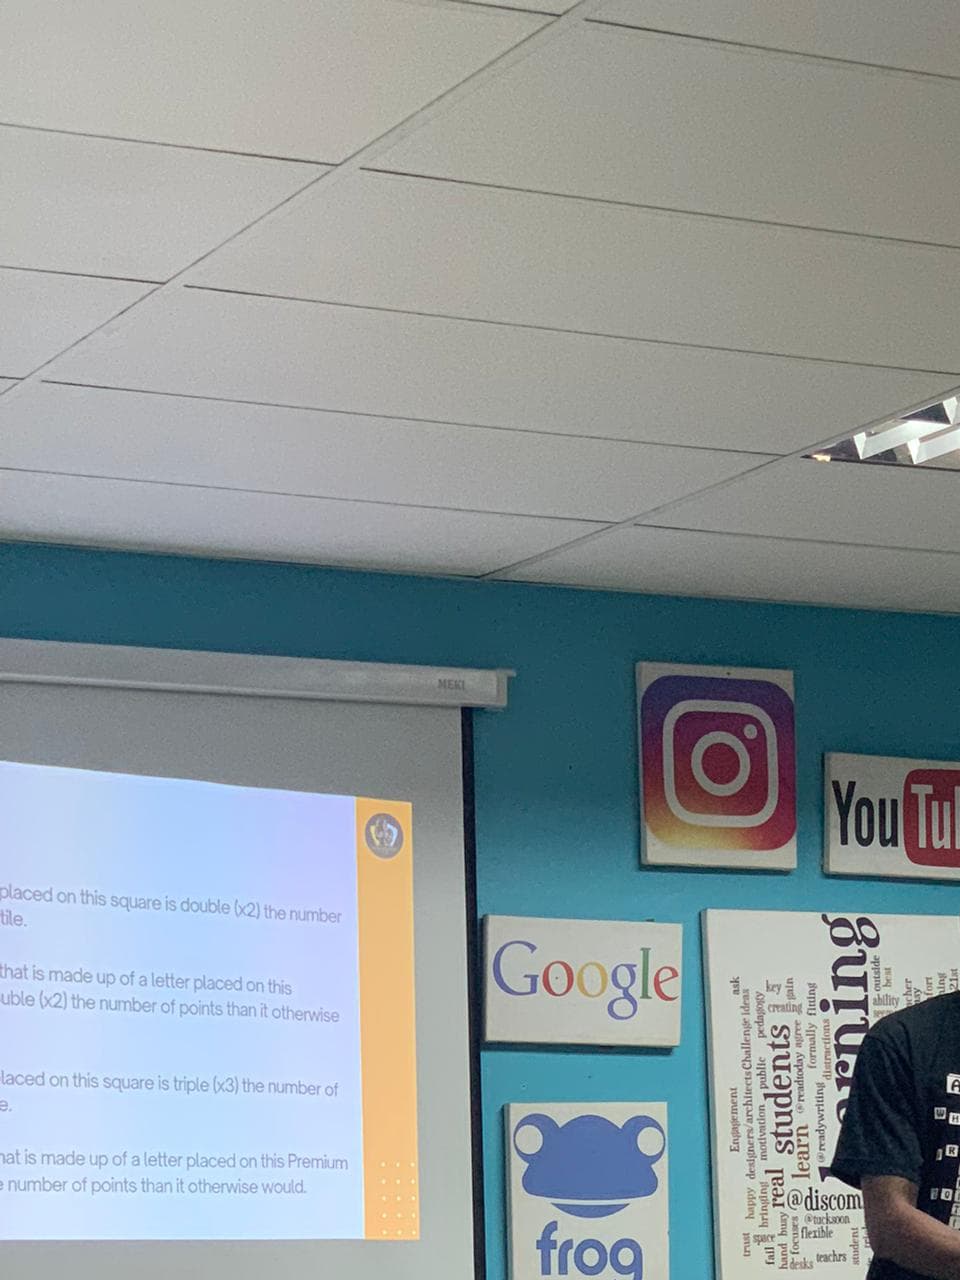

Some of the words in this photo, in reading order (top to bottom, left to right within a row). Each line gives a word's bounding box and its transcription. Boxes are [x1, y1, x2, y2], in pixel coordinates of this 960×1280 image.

[0, 884, 53, 902] placed
[57, 891, 76, 904] on
[80, 889, 106, 906] this
[111, 895, 161, 912] square
[166, 896, 176, 911] is
[180, 897, 230, 916] double
[234, 900, 260, 920] (x2)
[264, 904, 286, 920] the
[290, 907, 341, 924] number
[0, 910, 27, 927] tile.
[0, 964, 28, 980] that
[33, 965, 44, 981] is
[49, 968, 92, 983] made
[97, 972, 116, 987] up
[120, 971, 135, 985] of
[139, 975, 148, 987] a
[151, 972, 190, 991] letter
[194, 975, 243, 993] placed
[247, 979, 265, 993] on
[268, 978, 292, 995] this
[492, 940, 680, 1020] Google
[730, 976, 740, 995] ask
[786, 977, 795, 1000] gain
[871, 955, 880, 992] outside
[39, 994, 67, 1010] (x2)
[71, 993, 96, 1010] the
[100, 996, 157, 1013] number
[161, 998, 176, 1015] of
[179, 1000, 223, 1019] points
[226, 1001, 257, 1017] than
[260, 1003, 268, 1018] it
[272, 1006, 340, 1023] otherwise
[754, 991, 766, 1038] pedagogy
[807, 983, 818, 1016] fitting
[741, 1019, 753, 1070] Challenge
[795, 1020, 804, 1048] agree
[806, 1023, 817, 1069] formally
[823, 1018, 831, 1080] distractions
[49, 1074, 69, 1087] on
[73, 1073, 99, 1088] this
[103, 1077, 154, 1092] square
[159, 1075, 169, 1091] is
[173, 1076, 209, 1094] triple
[213, 1075, 239, 1095] (x3)
[242, 1077, 264, 1094] the
[268, 1079, 321, 1096] number
[325, 1081, 339, 1097] of
[757, 1056, 767, 1089] public
[763, 1024, 795, 1155] students
[730, 1088, 740, 1152] Engagement
[757, 1104, 768, 1160] motivation
[25, 1149, 36, 1165] is
[41, 1151, 85, 1166] made
[90, 1154, 108, 1169] up
[113, 1151, 128, 1166] of
[132, 1155, 140, 1166] a
[144, 1151, 183, 1168] letter
[186, 1153, 236, 1169] placed
[240, 1155, 257, 1169] on
[261, 1153, 285, 1169] this
[288, 1155, 348, 1171] Premium
[792, 1124, 810, 1179] learn
[8, 1177, 67, 1192] number
[72, 1177, 87, 1192] of
[91, 1177, 137, 1195] points
[141, 1178, 173, 1193] than
[176, 1179, 185, 1194] it
[188, 1179, 259, 1194] otherwise
[262, 1180, 307, 1195] would.
[745, 1187, 757, 1220] happy
[765, 1168, 784, 1208] real
[759, 1182, 769, 1228] bringing
[779, 1212, 789, 1236] busy
[790, 1216, 799, 1255] focuses
[801, 1226, 833, 1239] flexible
[779, 1243, 788, 1269] hand
[850, 1227, 859, 1265] student
